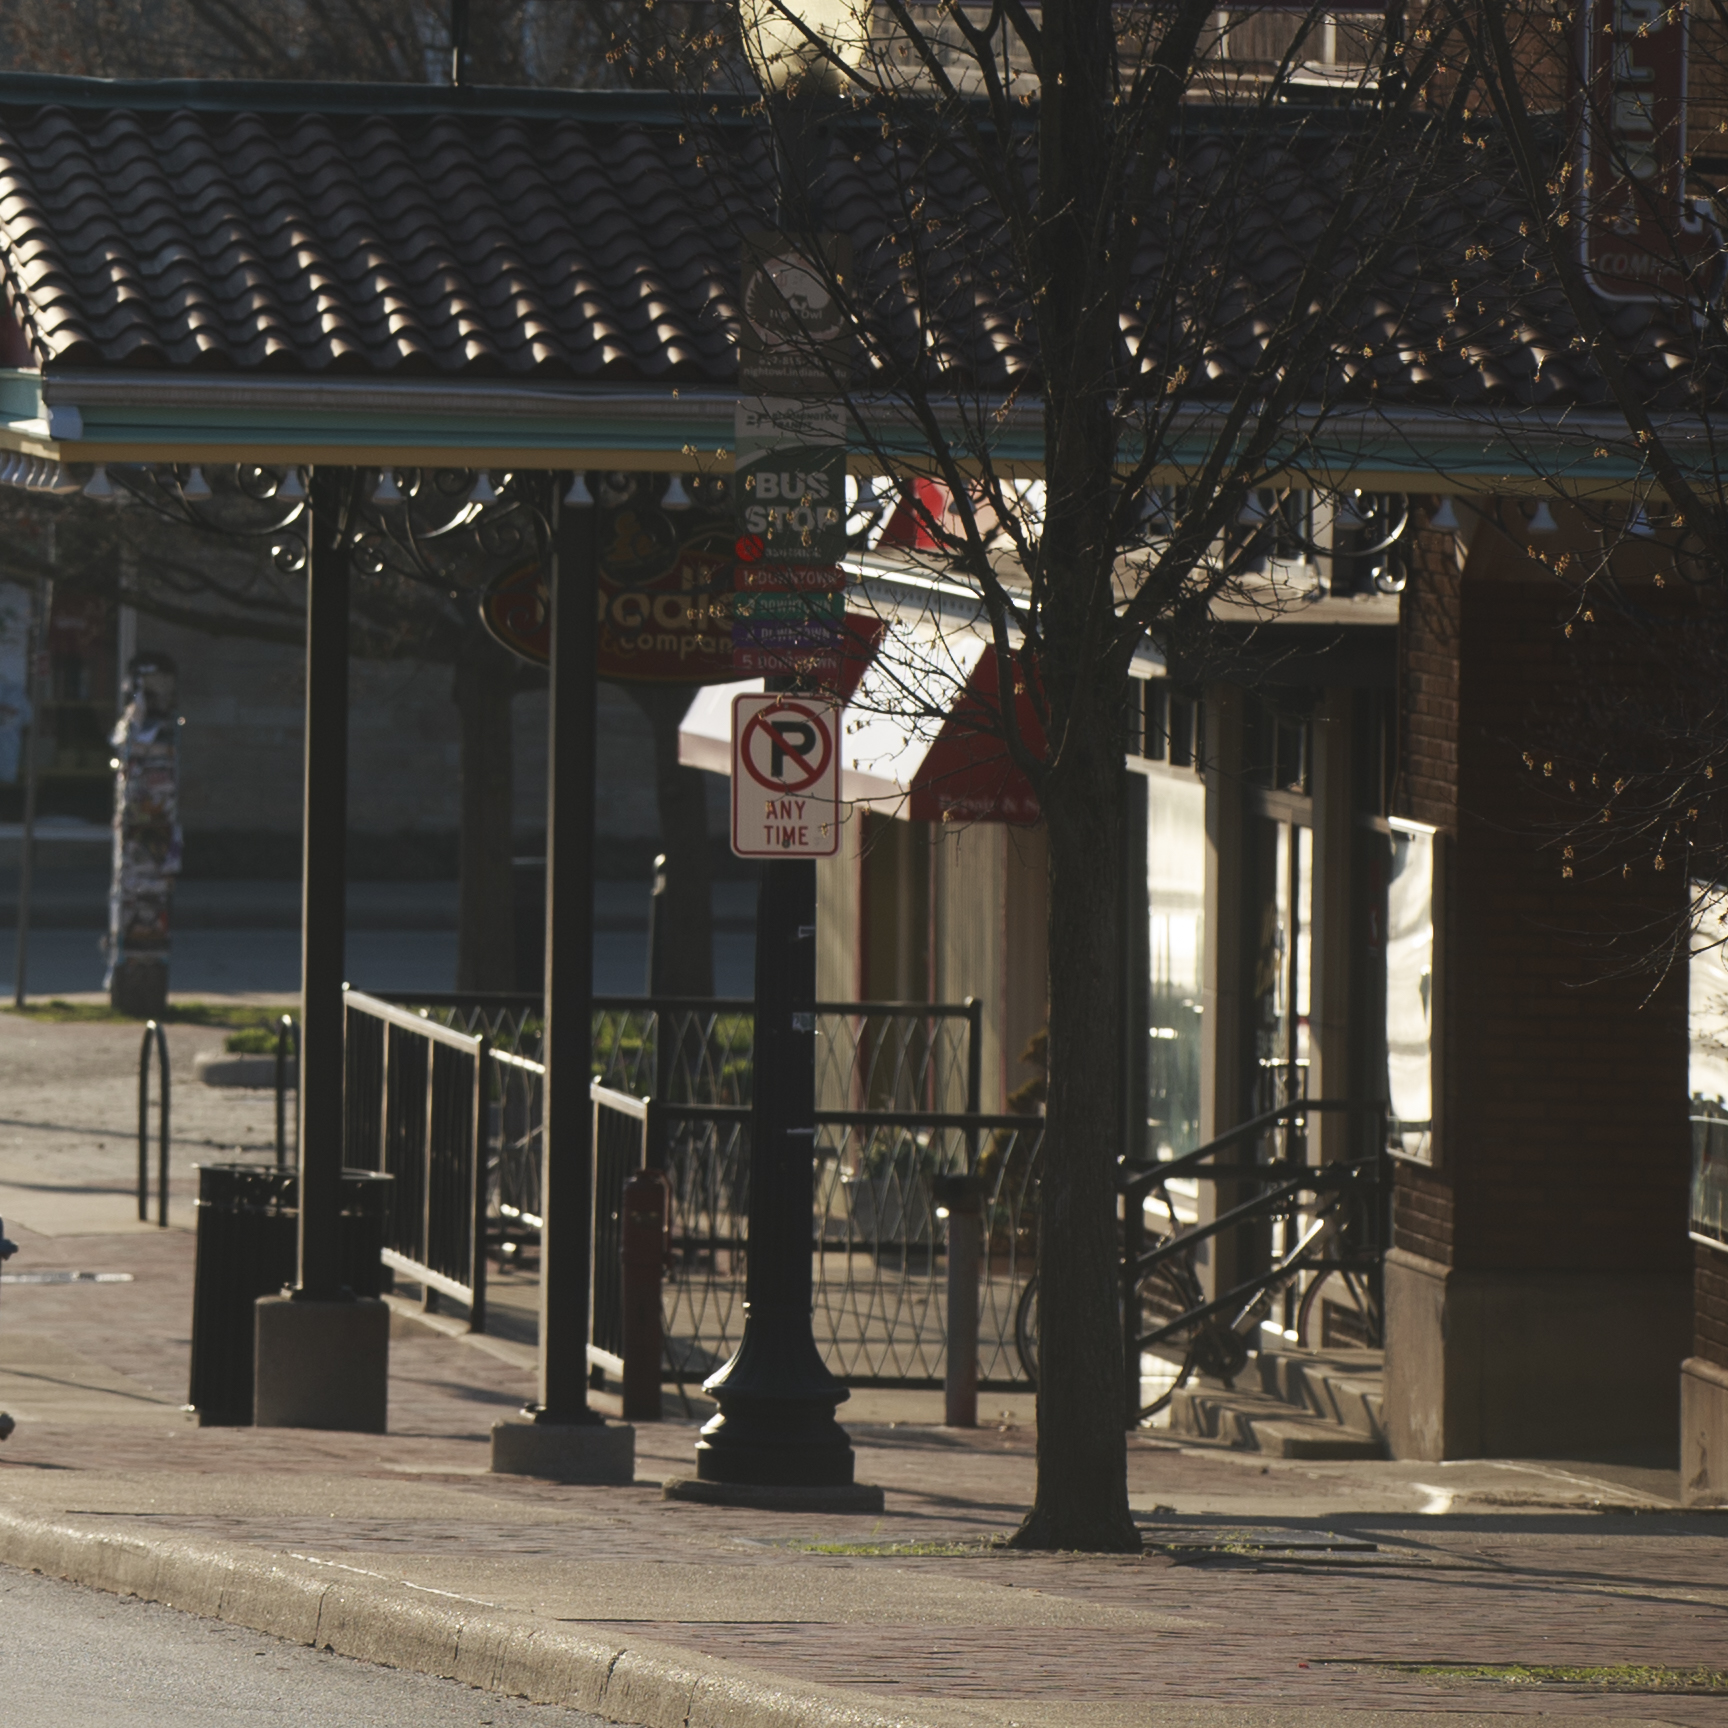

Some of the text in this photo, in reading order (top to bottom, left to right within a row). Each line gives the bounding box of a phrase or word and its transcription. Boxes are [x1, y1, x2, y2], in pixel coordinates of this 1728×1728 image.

[755, 472, 830, 499] BUS
[745, 505, 840, 533] STOP
[536, 565, 735, 631] odle
[619, 633, 734, 661] compan
[742, 655, 837, 669] 5 DOWNWN
[766, 800, 806, 819] ANY
[763, 825, 809, 845] TIME
